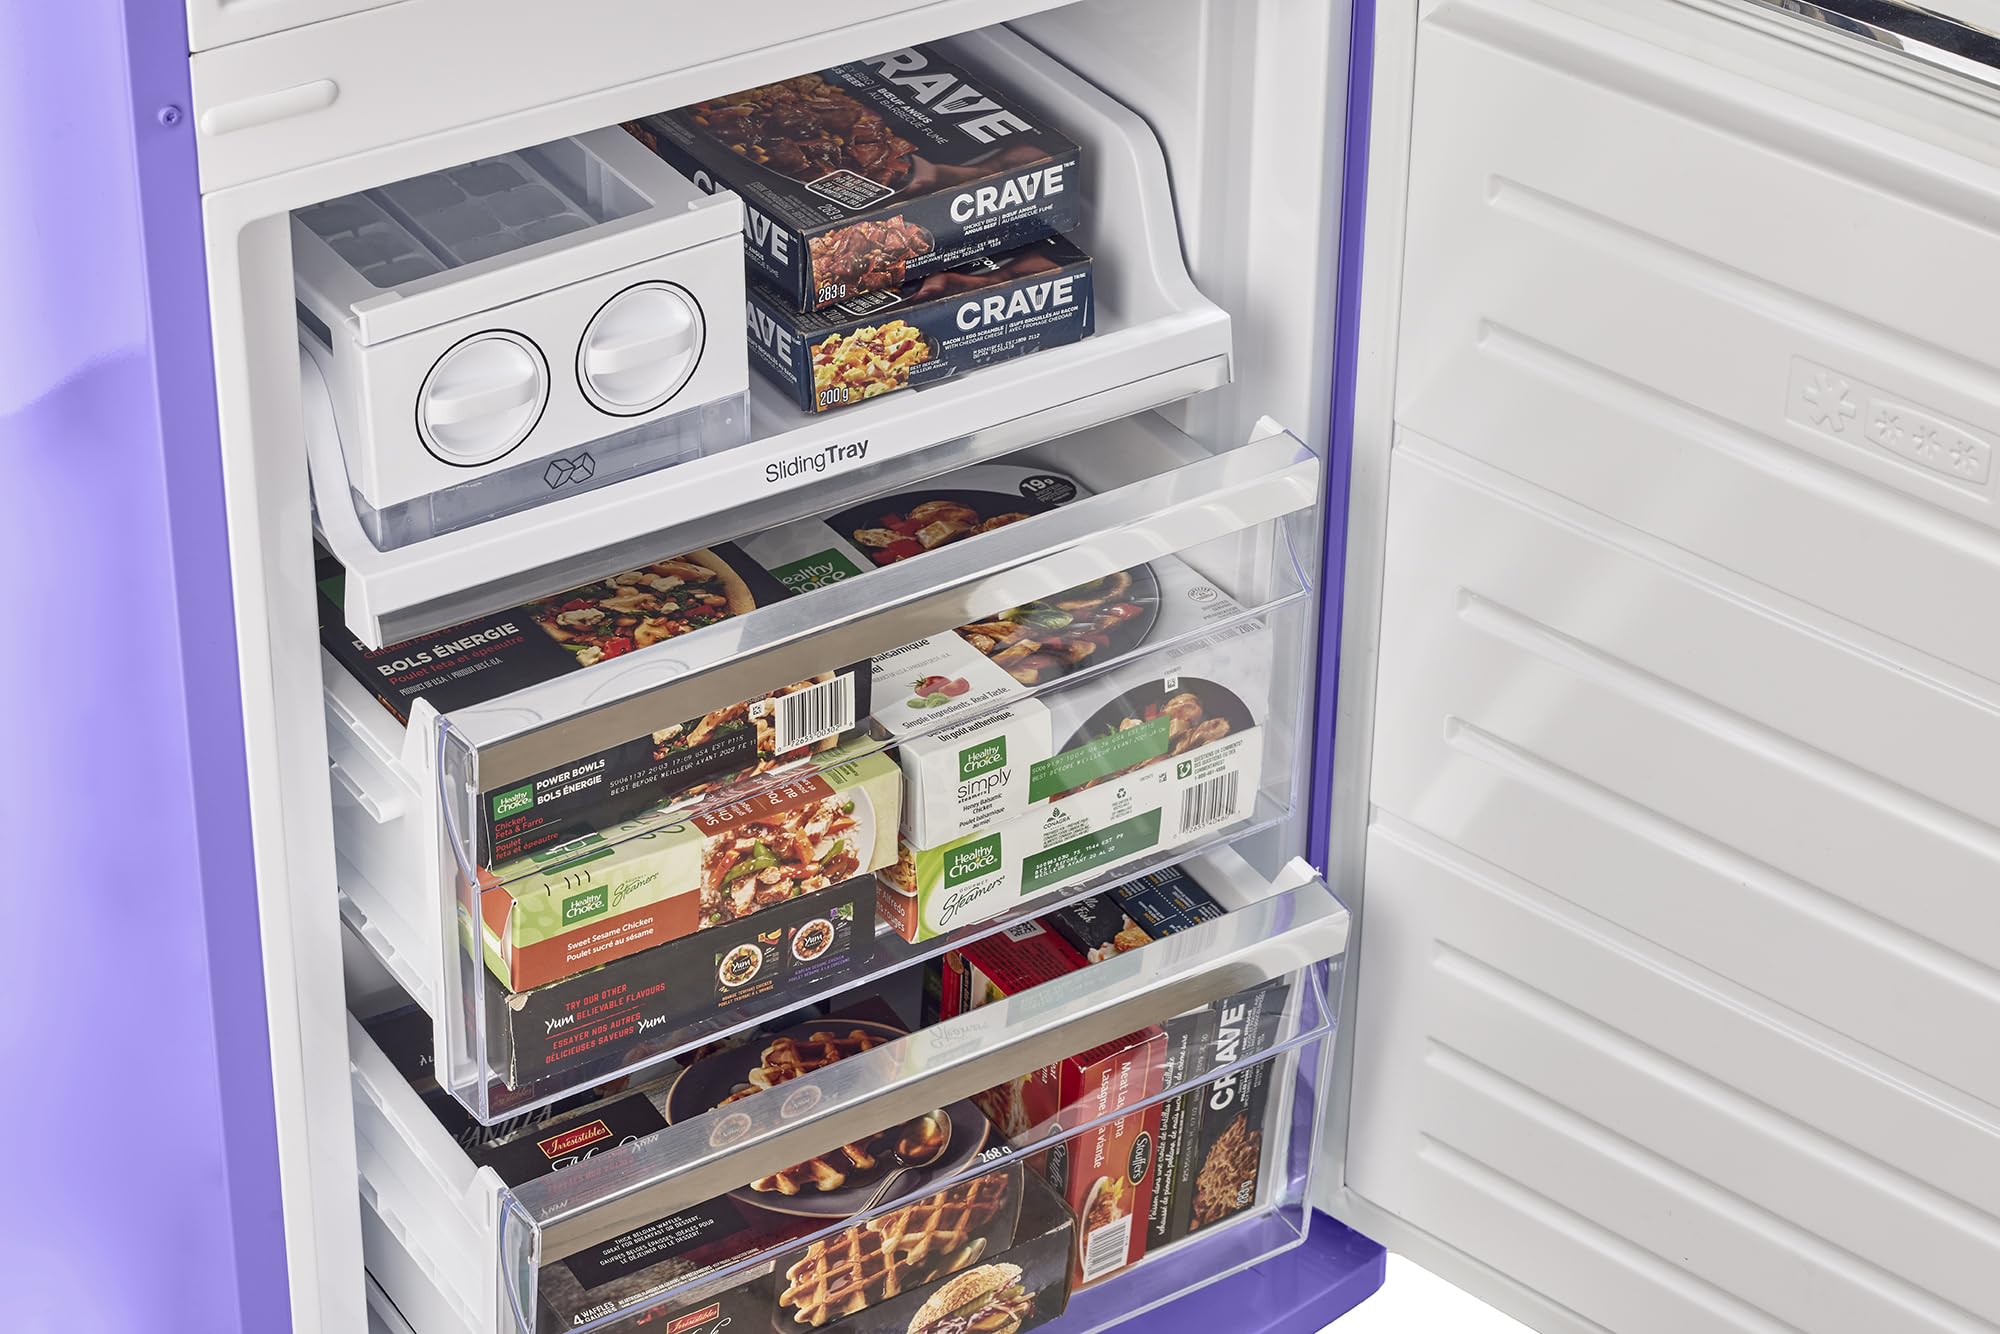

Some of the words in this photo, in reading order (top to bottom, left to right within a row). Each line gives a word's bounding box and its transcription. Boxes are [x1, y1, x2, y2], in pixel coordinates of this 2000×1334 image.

[863, 48, 1033, 144] RAVE
[900, 104, 932, 123] ANGUS
[951, 164, 1064, 222] CRAVE
[818, 284, 838, 303] 283
[839, 284, 846, 297] g
[956, 276, 1073, 330] CRAVE
[1061, 305, 1078, 315] BACON
[1009, 325, 1021, 333] AVEC
[942, 336, 960, 346] BACON
[944, 342, 958, 350] WITH
[820, 388, 840, 406] 200
[842, 388, 849, 402] g
[766, 440, 868, 482] SlidingTray
[782, 562, 833, 584] ealthy
[377, 652, 432, 676] BOLS
[432, 623, 519, 658] ÉNERGIE
[388, 668, 429, 685] Poulet
[431, 659, 456, 673] feta
[458, 655, 470, 663] et
[472, 635, 525, 659] épeautre
[872, 665, 884, 674] iel
[902, 715, 927, 729] Simple
[971, 693, 988, 704] Real
[938, 733, 950, 742] Un
[950, 726, 969, 738] goût
[969, 710, 1014, 732] authentique.
[712, 742, 725, 751] EST
[968, 746, 999, 761] Healthy
[964, 753, 1000, 773] Choice
[536, 772, 570, 791] POWER
[572, 759, 605, 777] BOWLS
[610, 785, 630, 796] BEST
[632, 775, 658, 788] BEFORE
[696, 753, 717, 765] AVANT
[958, 768, 1011, 799] simply
[500, 792, 527, 804] Healthy
[537, 791, 562, 805] BOLS
[563, 775, 602, 795] ÉNERGIE
[959, 791, 987, 804] steamers
[497, 798, 528, 814] Choice
[963, 800, 979, 811] Honey
[973, 804, 992, 814] Chicken
[495, 815, 526, 832] Chicken
[496, 829, 513, 839] Feta
[522, 817, 543, 828] Farro
[959, 817, 976, 828] Poulet
[1043, 816, 1071, 830] CONAGRA
[496, 838, 521, 853] Poulet
[496, 849, 511, 860] feta
[513, 846, 521, 855] et
[524, 832, 558, 850] épeautre
[955, 846, 993, 865] Healthy
[949, 855, 994, 878] Choice
[571, 894, 601, 908] Healthy
[612, 873, 657, 907] Steamers
[566, 901, 602, 919] Choice
[882, 891, 905, 917] Alfredo
[940, 880, 1002, 926] Steamers
[884, 909, 904, 932] rouges
[567, 949, 591, 962] Poulet
[592, 940, 613, 953] sucré
[615, 937, 624, 945] au
[626, 927, 654, 942] sésame
[568, 937, 590, 951] Sweet
[592, 927, 621, 942] Sesame
[622, 917, 653, 931] Chicken
[565, 1000, 581, 1012] TRY
[583, 993, 599, 1006] OUR
[602, 984, 627, 1000] OTHER
[576, 997, 624, 1020] BELIEVABLE
[626, 982, 666, 1003] FLAVOURS
[553, 1031, 589, 1049] ESSAYER
[591, 1023, 608, 1036] NOS
[610, 1012, 640, 1029] AUTRES
[545, 1040, 596, 1064] DÉLICIEUSES
[598, 1026, 634, 1045] SAVEURS
[1119, 1062, 1131, 1089] Meat
[1096, 1068, 1112, 1110] Lasagne
[1114, 1092, 1127, 1138] Lasgna
[1160, 1196, 1169, 1205] de
[1167, 1129, 1177, 1139] de
[1173, 1071, 1183, 1081] de
[1180, 1034, 1189, 1050] sure
[1158, 1132, 1167, 1141] de
[978, 1147, 1002, 1163] 268
[1094, 1135, 1106, 1168] viande
[1132, 1137, 1148, 1179] Stouffer's
[1155, 1163, 1163, 1176] une
[1151, 1177, 1161, 1194] dans
[1148, 1196, 1160, 1221] Poisson
[614, 1236, 631, 1245] THICK
[632, 1227, 656, 1239] BELGIAN
[656, 1216, 682, 1229] WAFFLES
[600, 1253, 626, 1266] GAUFRES
[626, 1245, 647, 1256] BELGES
[699, 1219, 714, 1228] POUR
[602, 1245, 621, 1255] GREAT
[573, 1315, 584, 1325] 4
[581, 1301, 614, 1317] WAFFLES
[584, 1308, 618, 1324] GAUFRES
